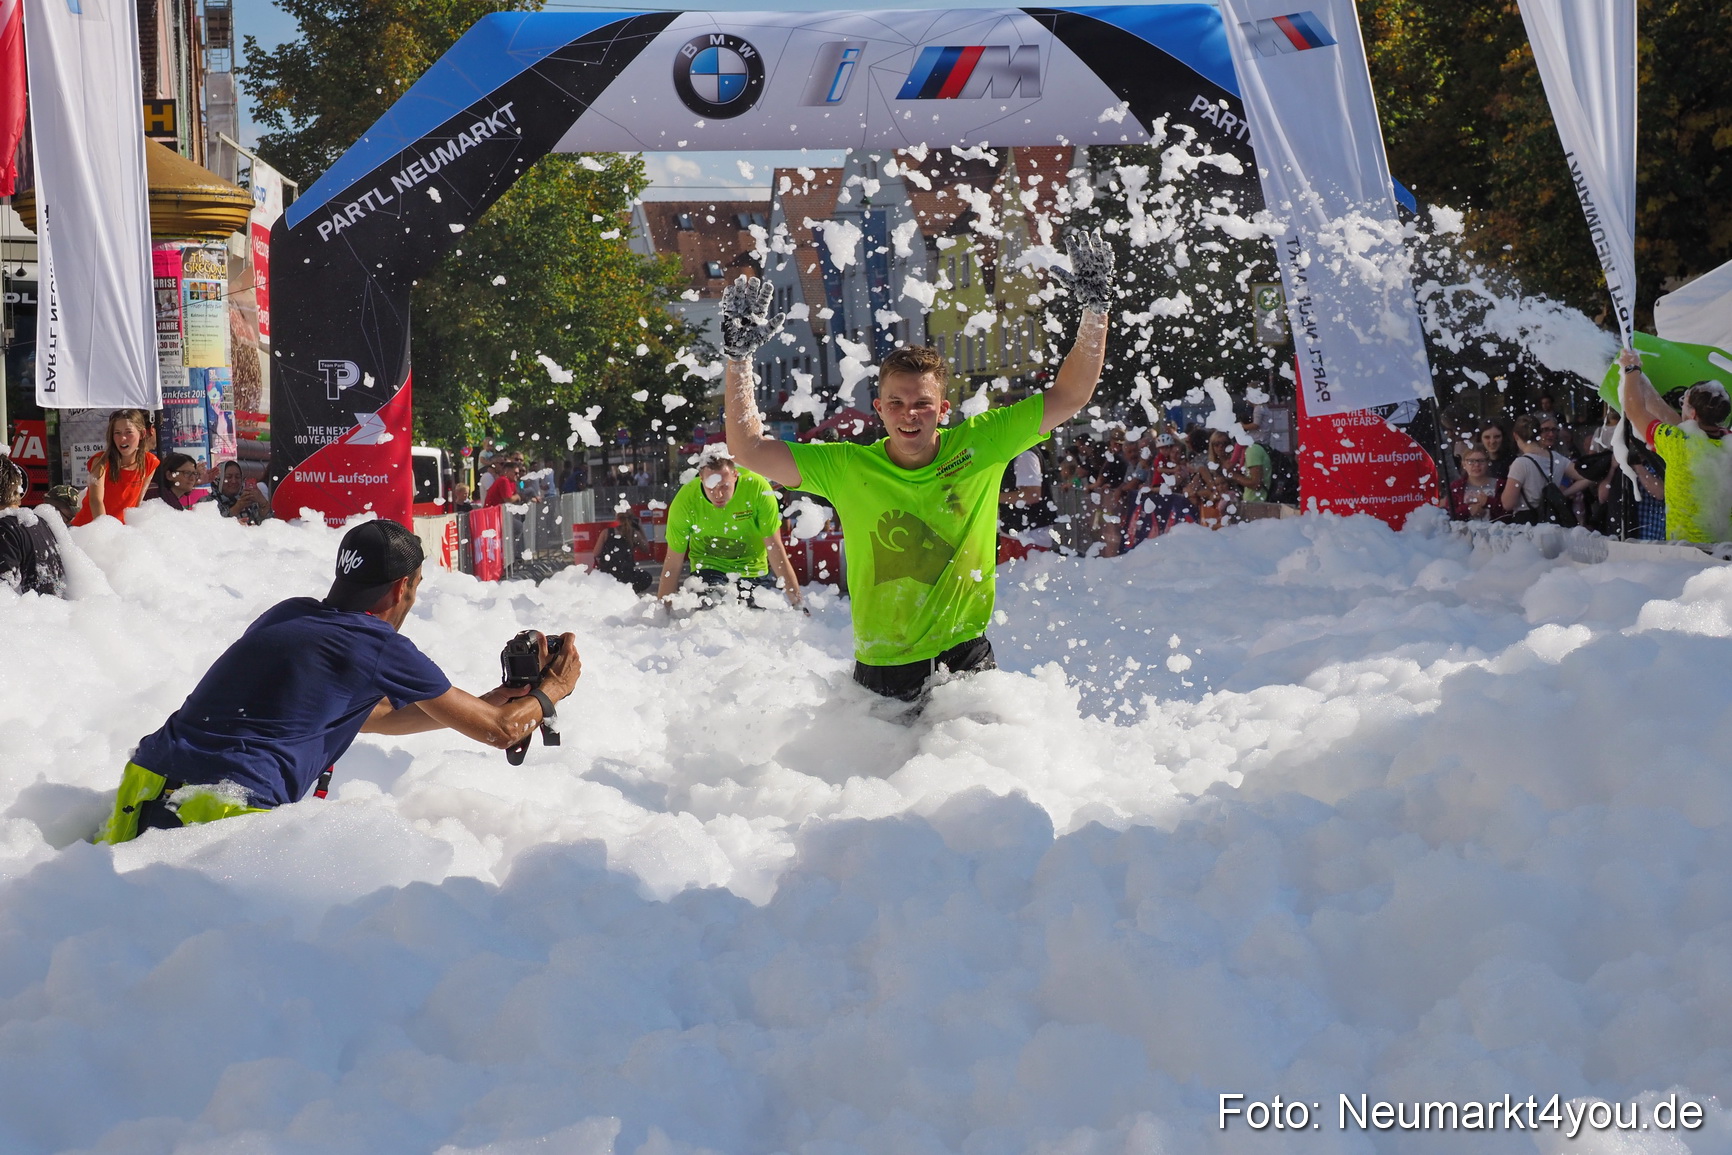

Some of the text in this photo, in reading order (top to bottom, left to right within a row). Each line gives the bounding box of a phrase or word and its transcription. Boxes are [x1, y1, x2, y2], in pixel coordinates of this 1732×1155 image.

[680, 33, 756, 59] BMW
[317, 101, 517, 243] PARTL NEUMARKT
[157, 321, 179, 332] JAHRE
[1365, 406, 1389, 416] NEXT
[1331, 415, 1380, 427] 100 YEARS
[306, 426, 351, 436] THE NEXT
[293, 435, 339, 445] 100 YEARS
[1332, 450, 1423, 465] BMW Laufsport
[294, 471, 389, 486] BMW Laufsport
